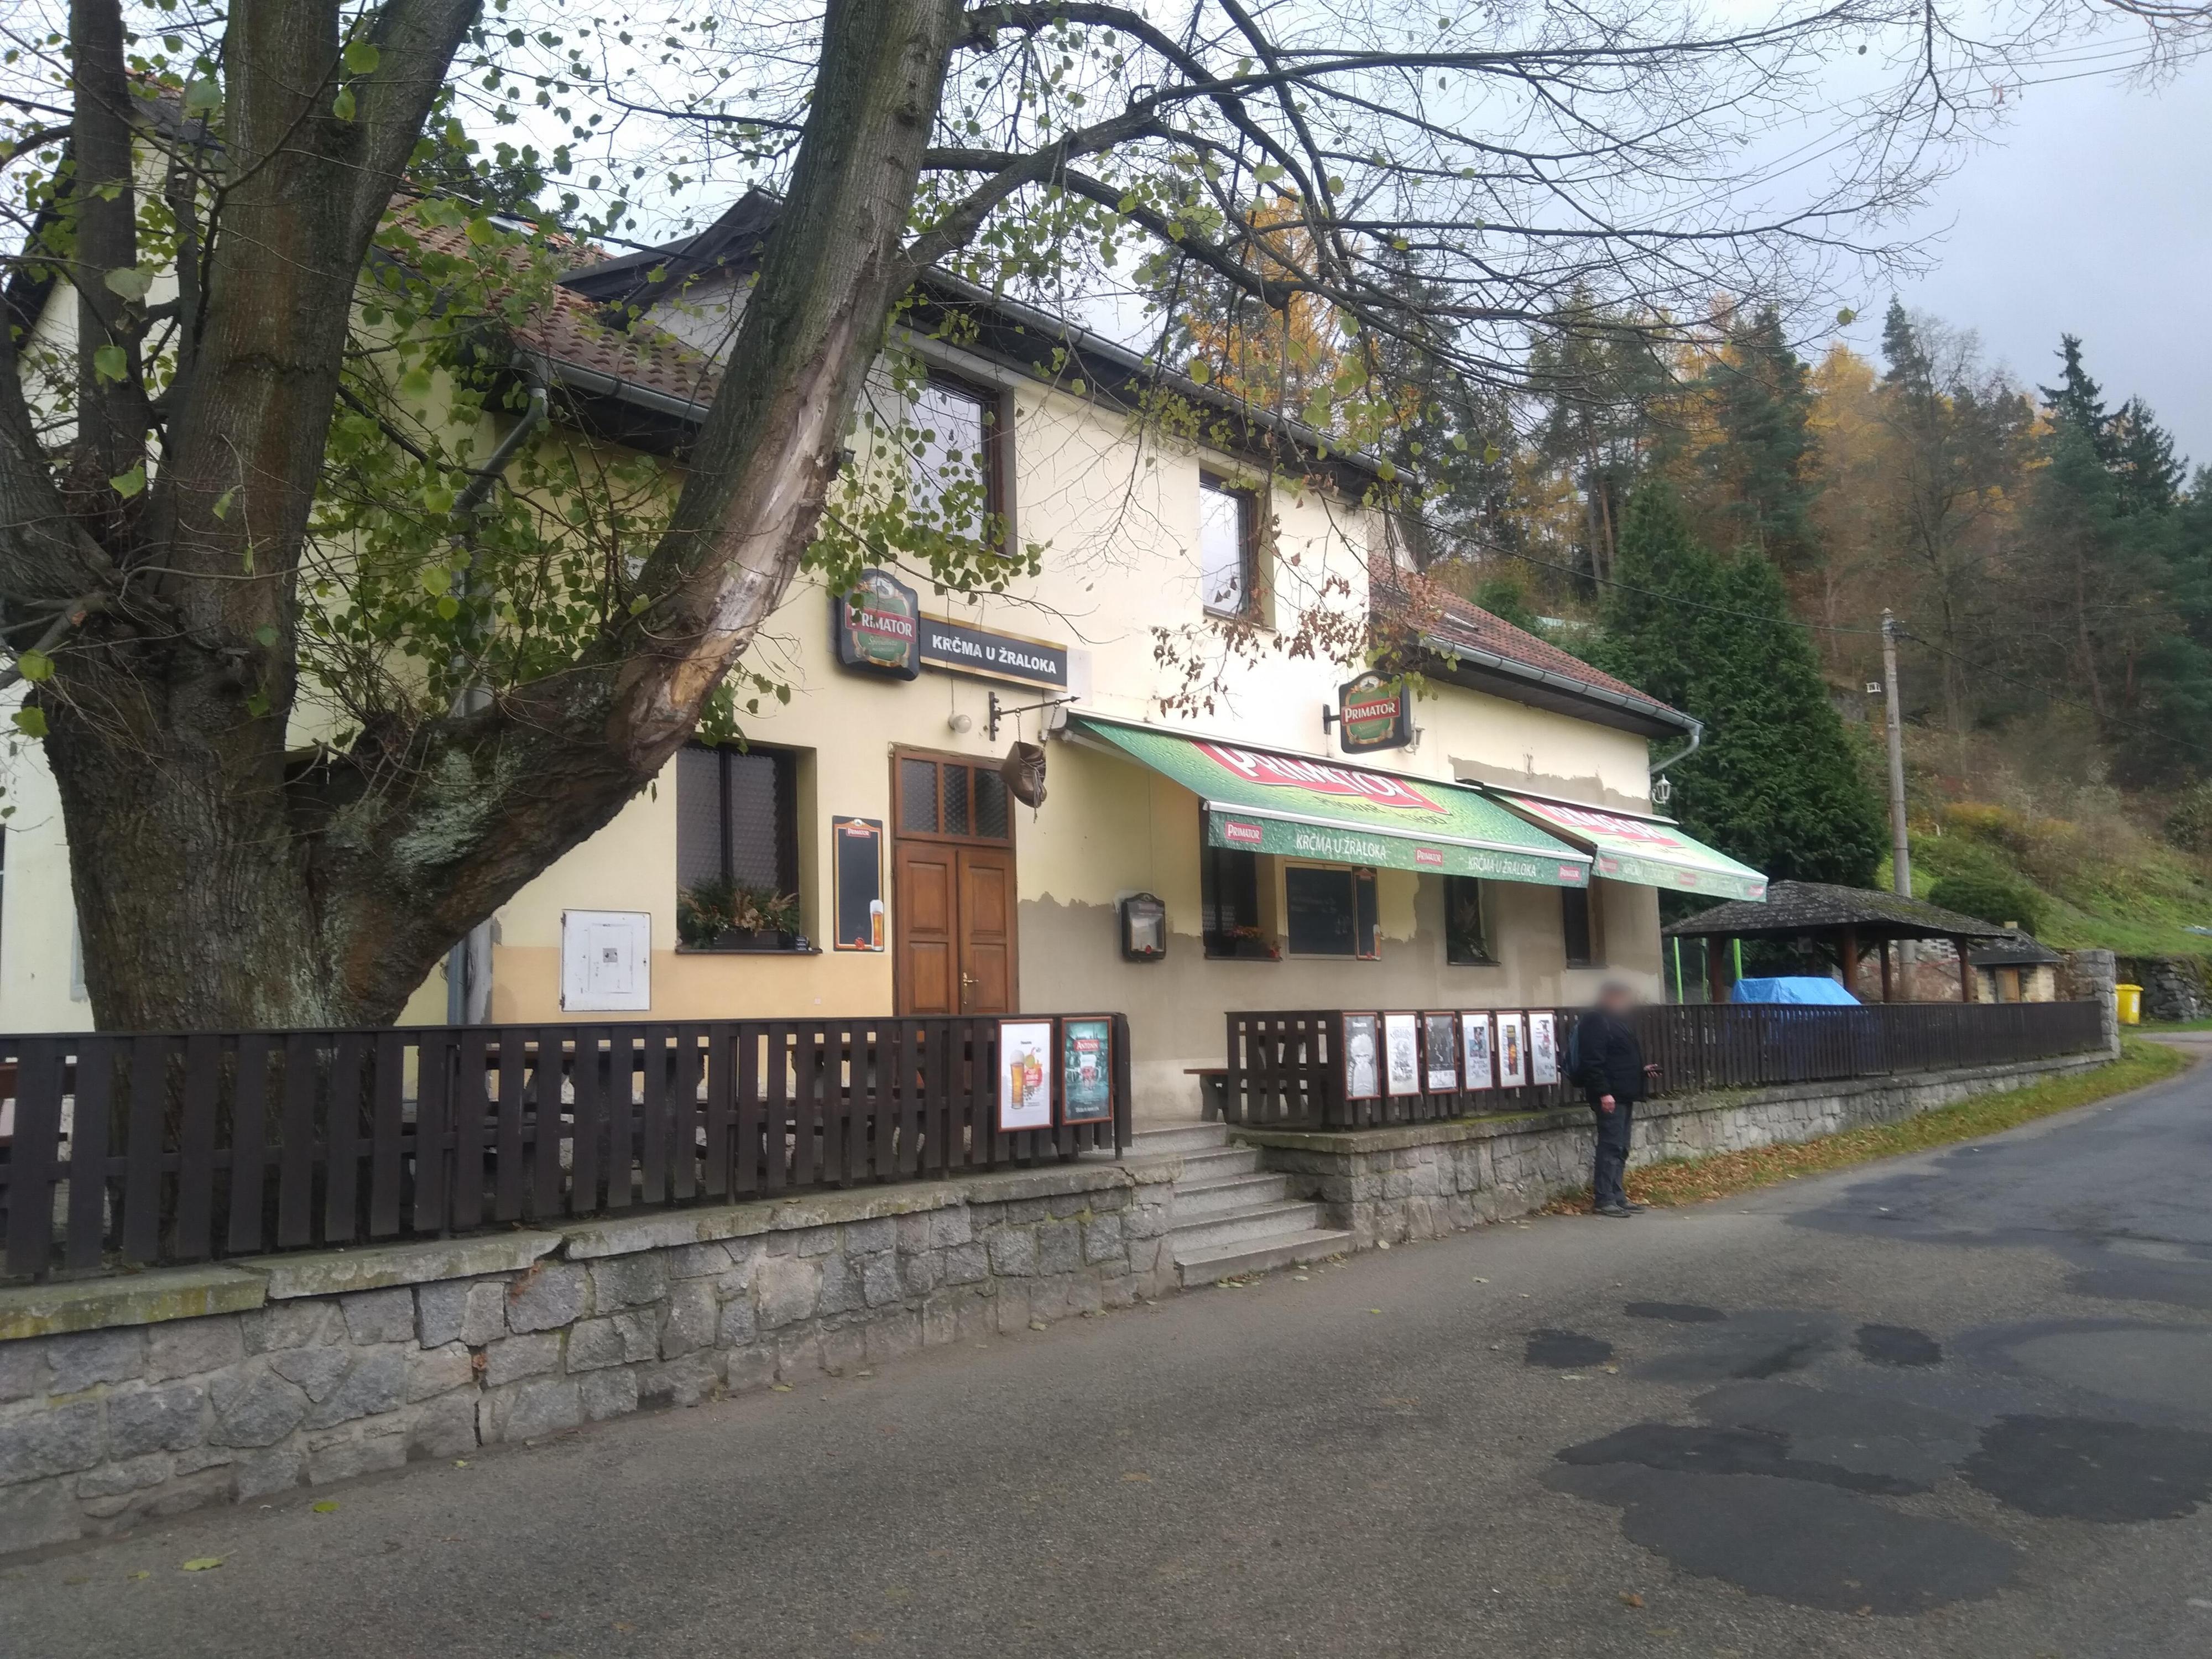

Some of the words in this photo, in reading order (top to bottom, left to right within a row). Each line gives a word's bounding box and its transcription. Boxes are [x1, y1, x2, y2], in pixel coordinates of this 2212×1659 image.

[932, 634, 983, 658] KRČMA
[985, 646, 995, 661] U
[998, 646, 1057, 675] ŽRALOKA
[1344, 702, 1396, 723] PRIMATOR
[1206, 743, 1424, 803] PRIMATOR
[1227, 824, 1260, 839] PRIMATOR
[1296, 833, 1332, 852] KRČMA
[1333, 840, 1342, 852] U
[1344, 837, 1386, 859] ŽRALOKA
